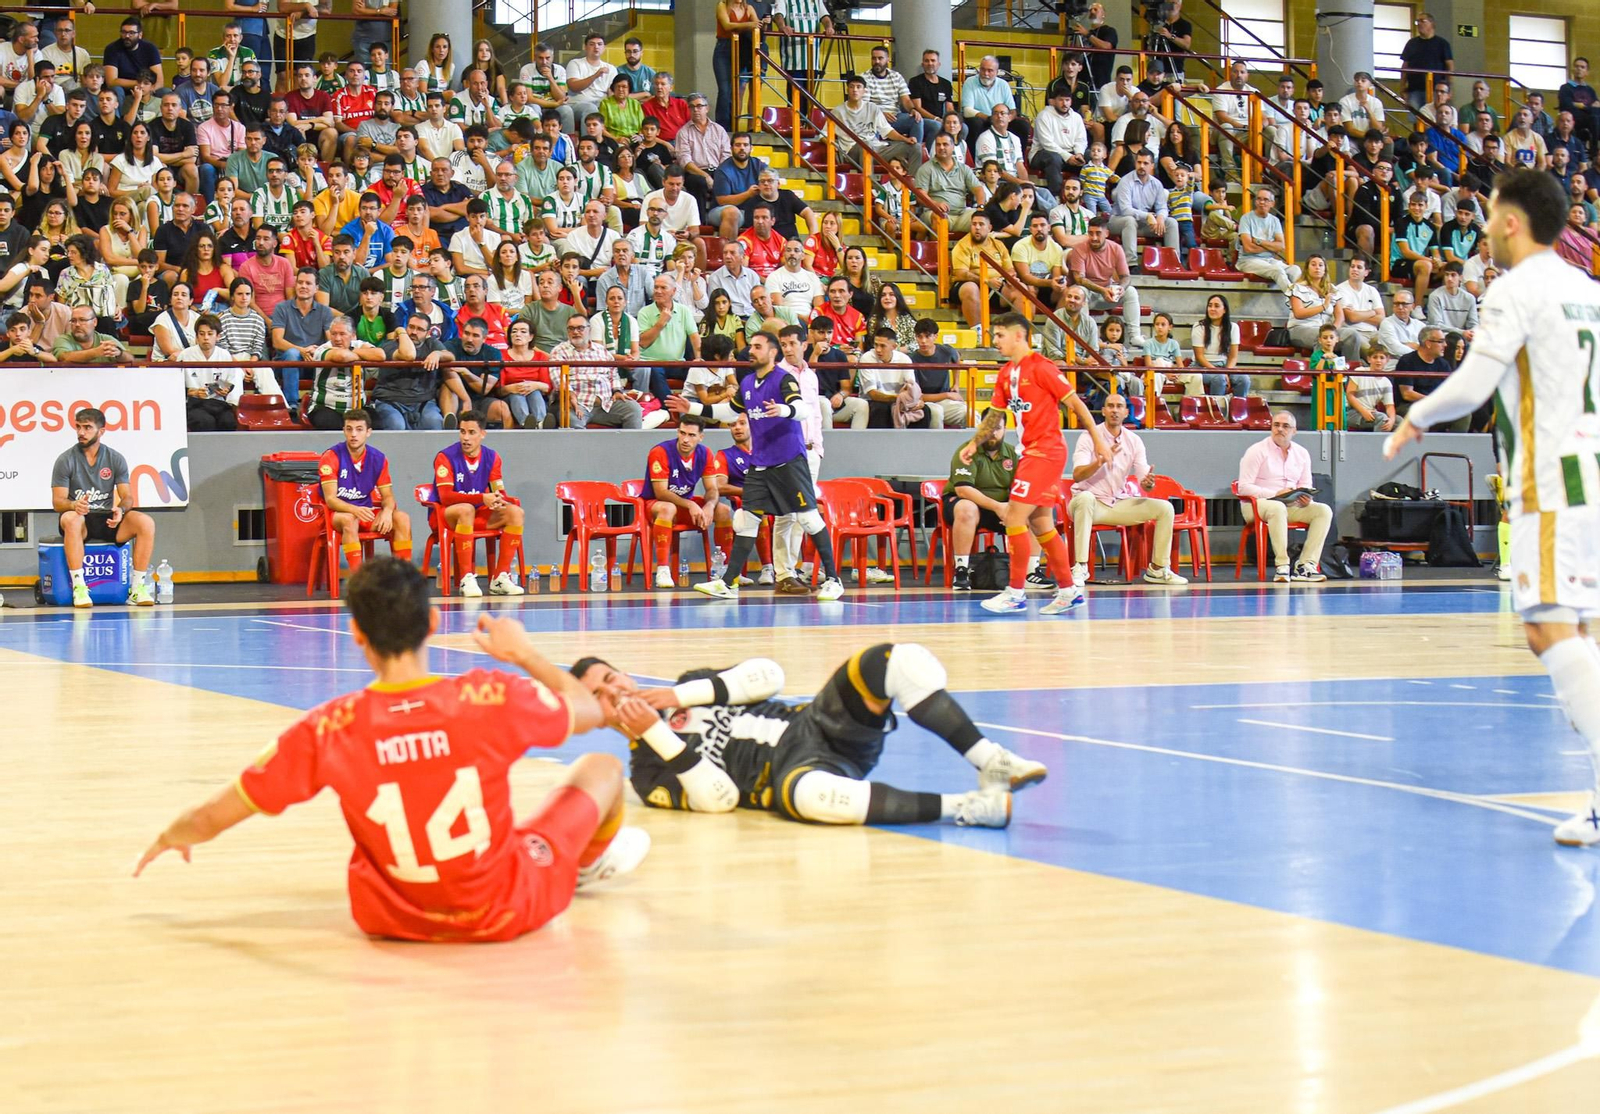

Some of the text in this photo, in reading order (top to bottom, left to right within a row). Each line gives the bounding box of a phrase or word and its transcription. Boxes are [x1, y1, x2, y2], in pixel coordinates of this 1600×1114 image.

[1011, 479, 1031, 498] 23
[797, 491, 807, 507] 1
[83, 554, 115, 565] QUA
[375, 730, 451, 766] MOTTA
[366, 766, 491, 884] 14
